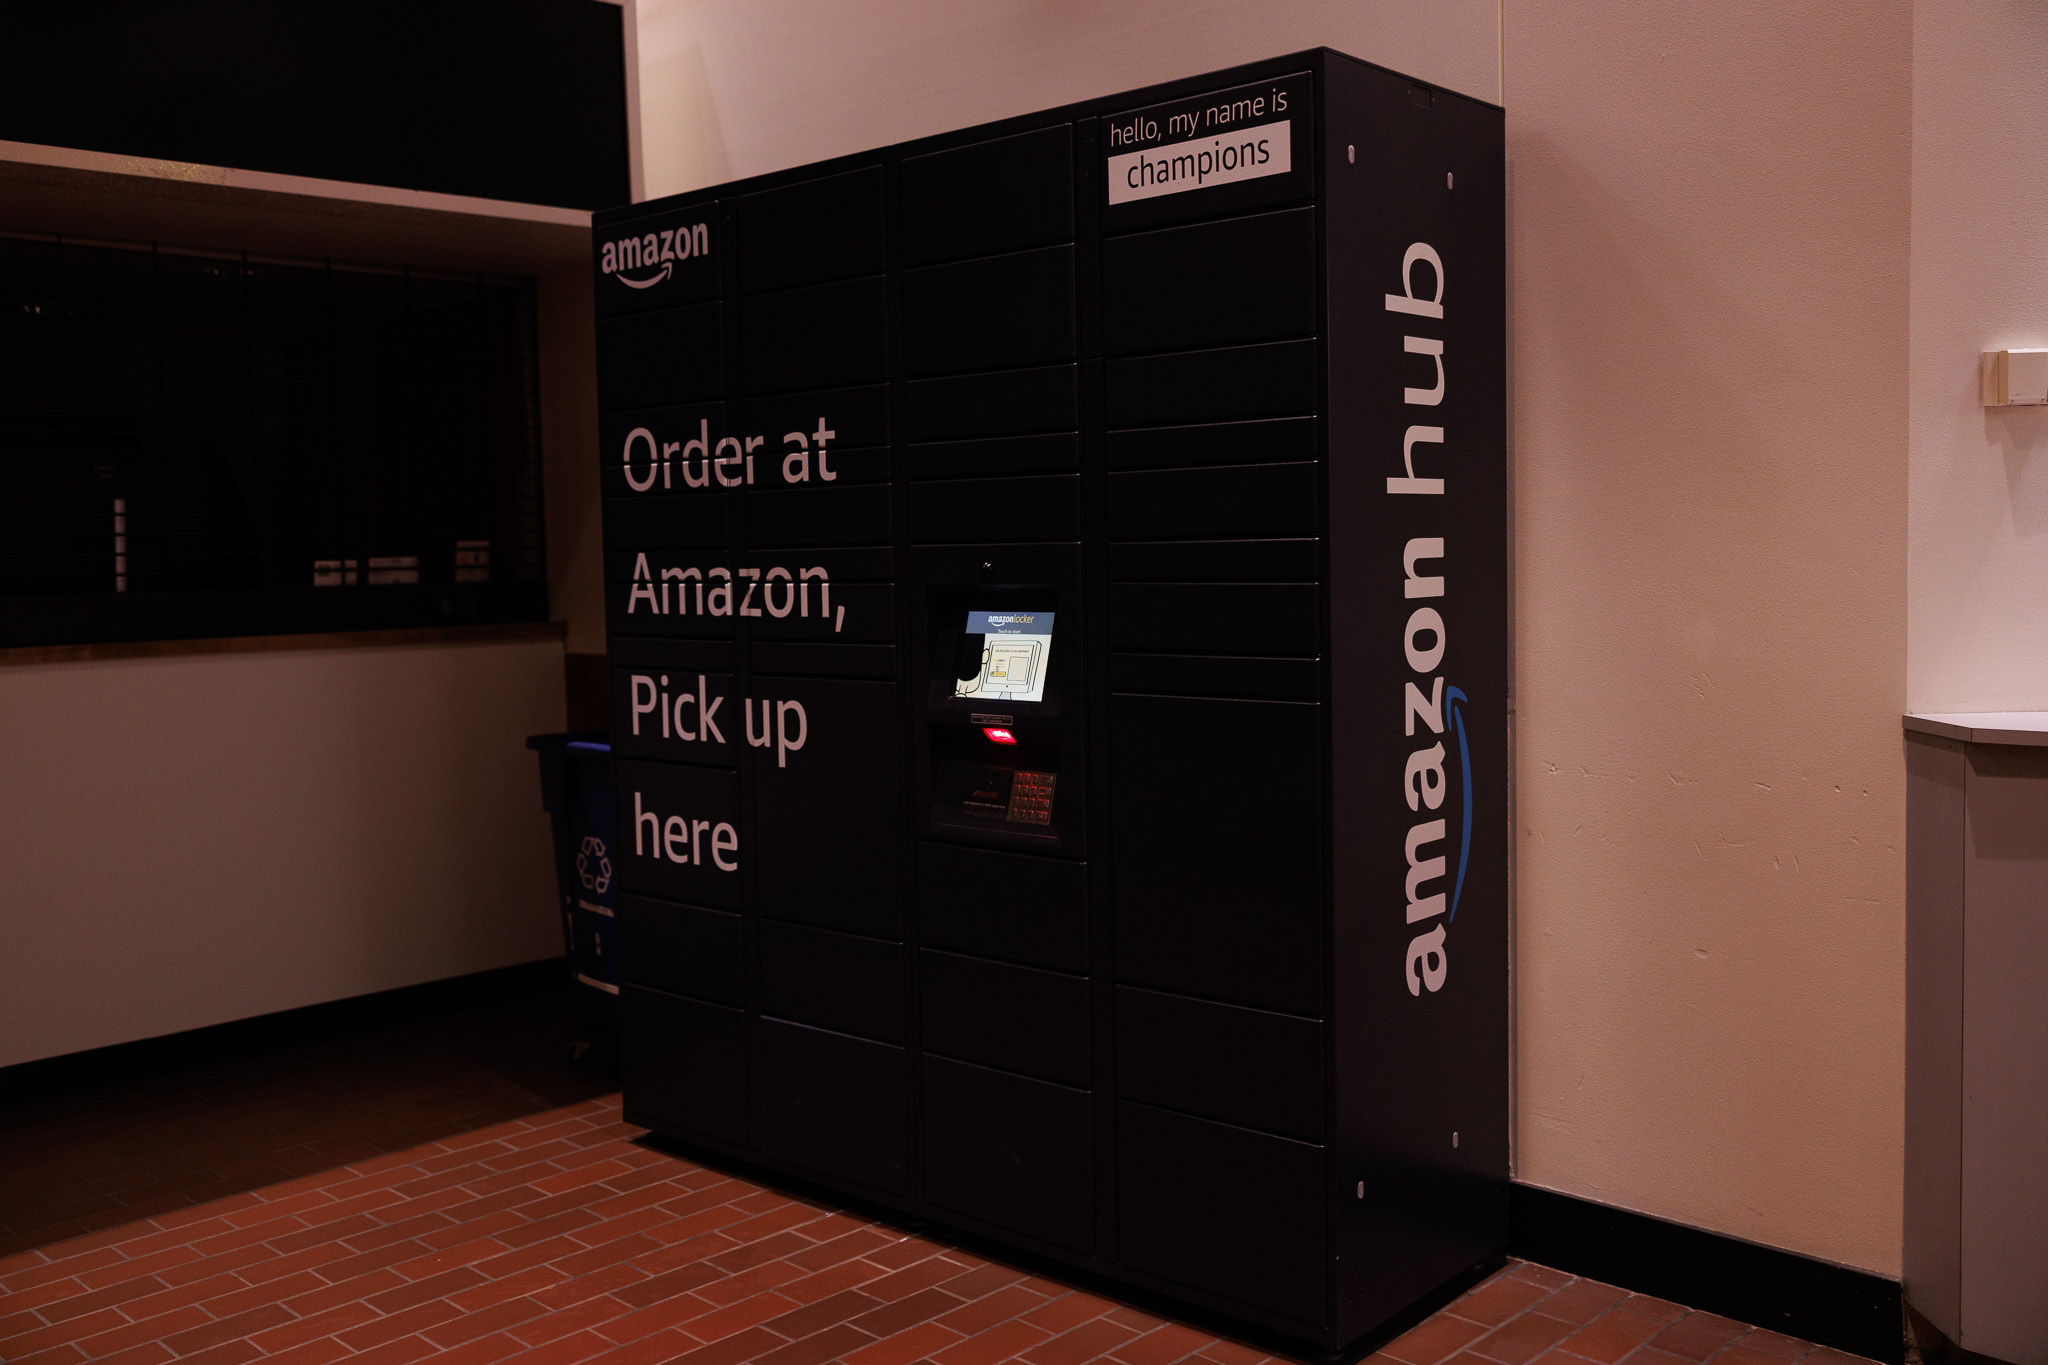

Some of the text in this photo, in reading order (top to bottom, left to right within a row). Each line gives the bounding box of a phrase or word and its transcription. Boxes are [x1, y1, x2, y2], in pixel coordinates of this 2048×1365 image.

[1110, 88, 1288, 148] hello, my name is
[1127, 139, 1270, 189] champions
[601, 222, 710, 275] amazon
[622, 416, 838, 492] Order at
[627, 551, 847, 634] Amazon,
[1384, 242, 1447, 997] amazon hub
[630, 674, 809, 768] Pick up
[633, 791, 739, 872] here
